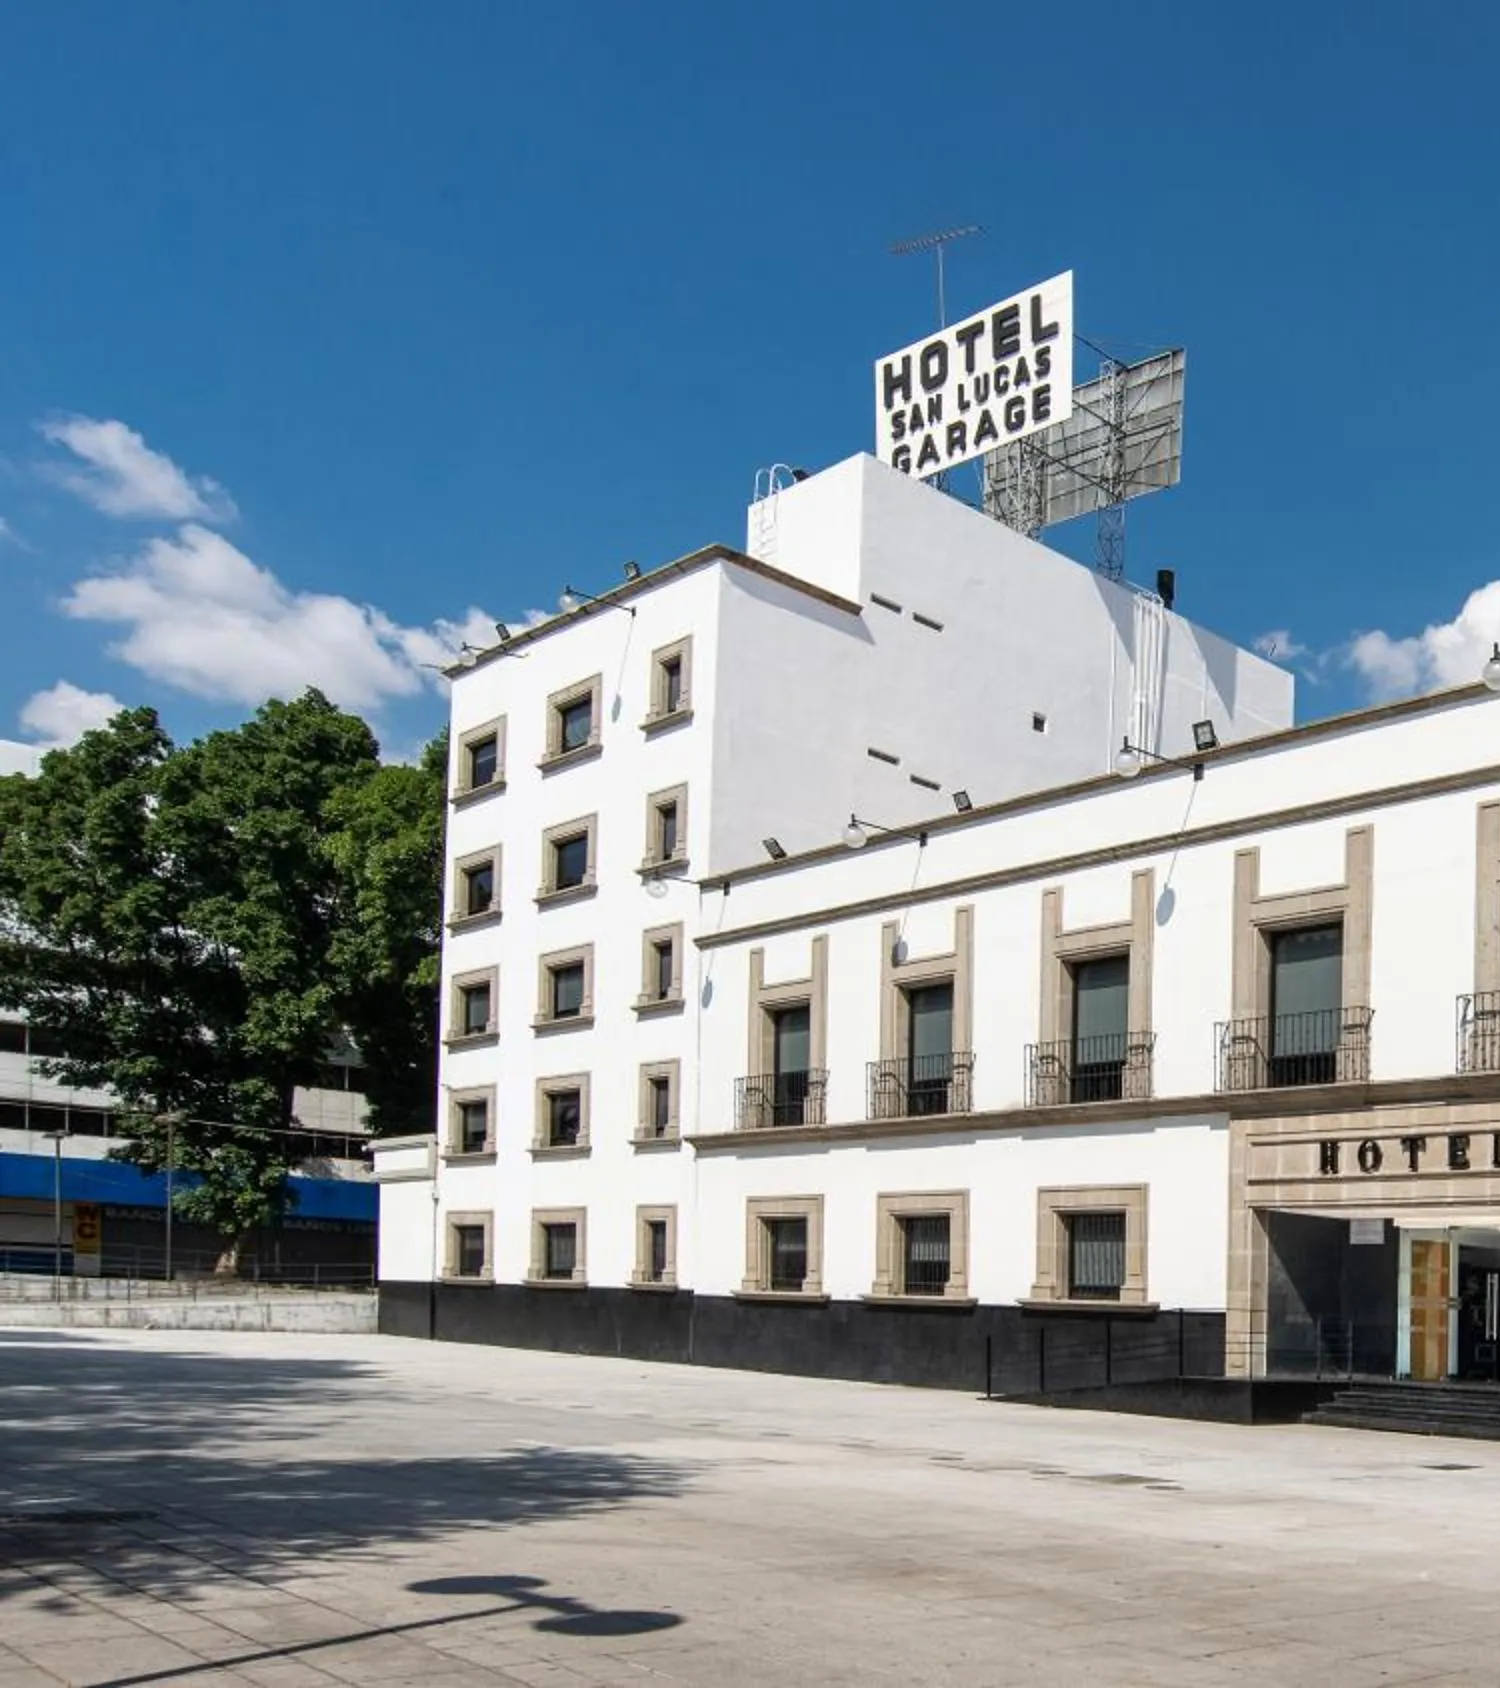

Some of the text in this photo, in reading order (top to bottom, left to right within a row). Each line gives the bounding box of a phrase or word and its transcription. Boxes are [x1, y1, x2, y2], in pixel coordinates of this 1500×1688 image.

[883, 293, 1059, 411] HOTEL
[891, 345, 1051, 441] SAN LUCAS
[892, 383, 1051, 474] GARAGE
